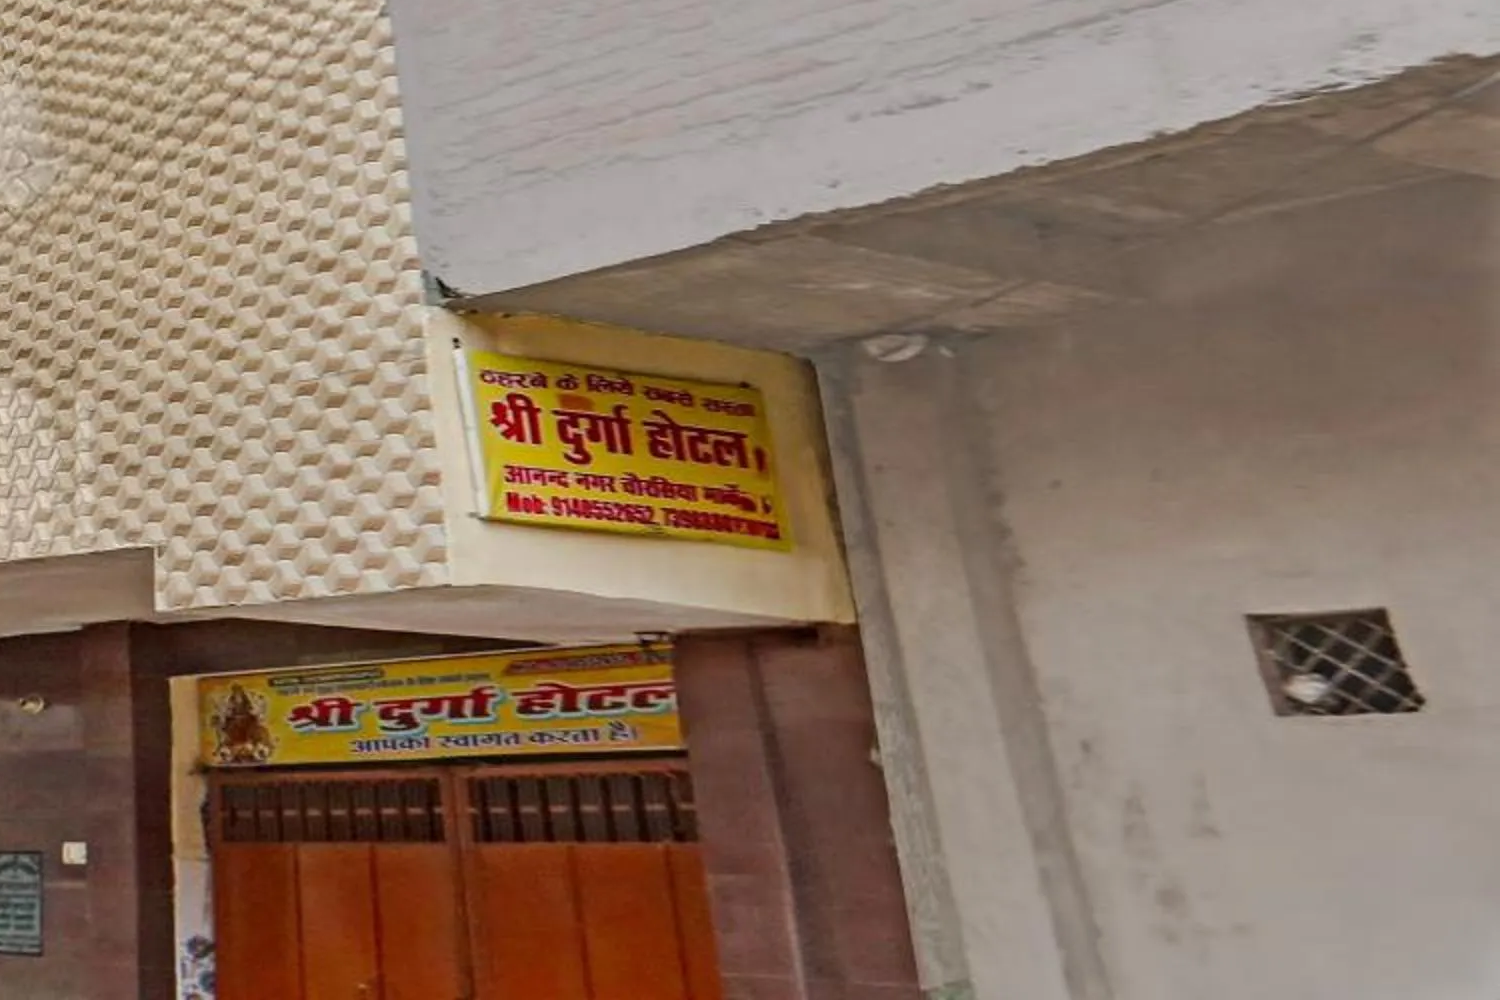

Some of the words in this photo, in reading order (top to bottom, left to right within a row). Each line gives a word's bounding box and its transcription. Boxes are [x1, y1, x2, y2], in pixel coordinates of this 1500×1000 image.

[490, 393, 541, 445] श्री
[552, 404, 633, 465] दुर्गा
[287, 695, 364, 730] श्री
[373, 684, 498, 732] दुर्गा
